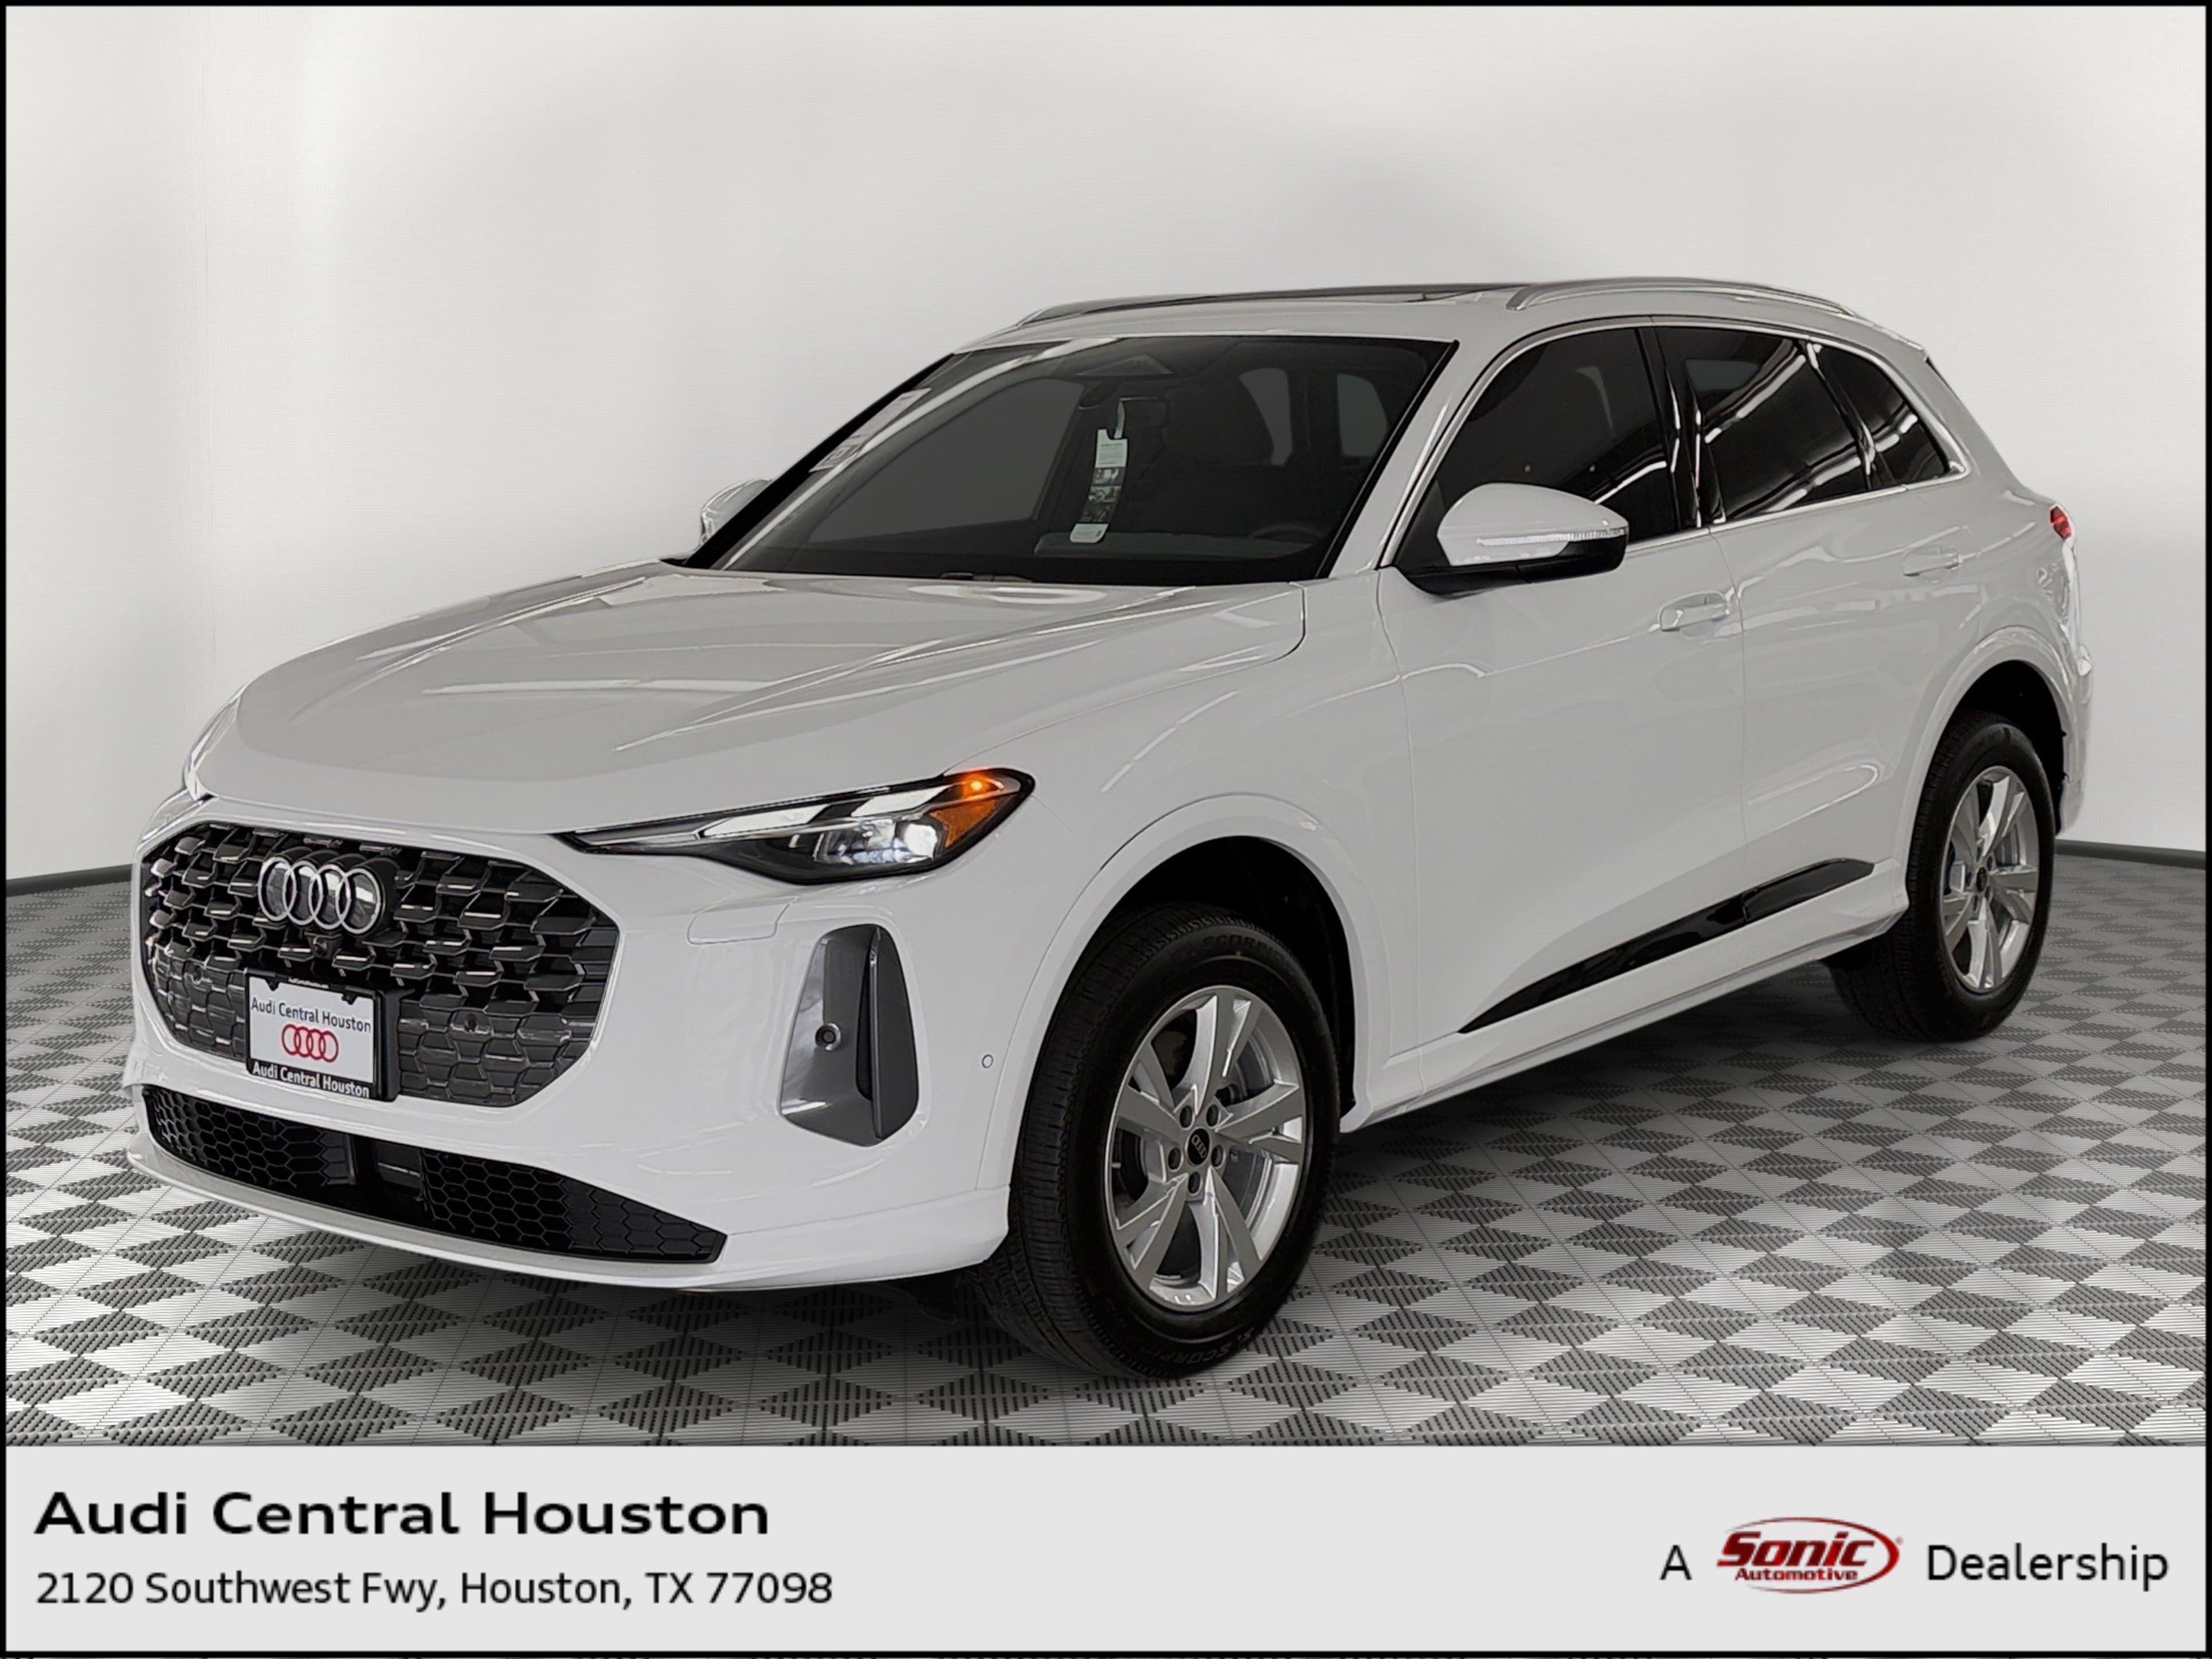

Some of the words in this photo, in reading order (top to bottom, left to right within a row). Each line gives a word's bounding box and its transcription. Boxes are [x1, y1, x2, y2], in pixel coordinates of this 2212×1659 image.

[251, 997, 276, 1015] Audi
[279, 1002, 319, 1023] Central
[322, 1010, 371, 1033] Houston
[252, 1061, 278, 1078] Audi
[280, 1066, 320, 1089] Central
[323, 1075, 370, 1098] Houston
